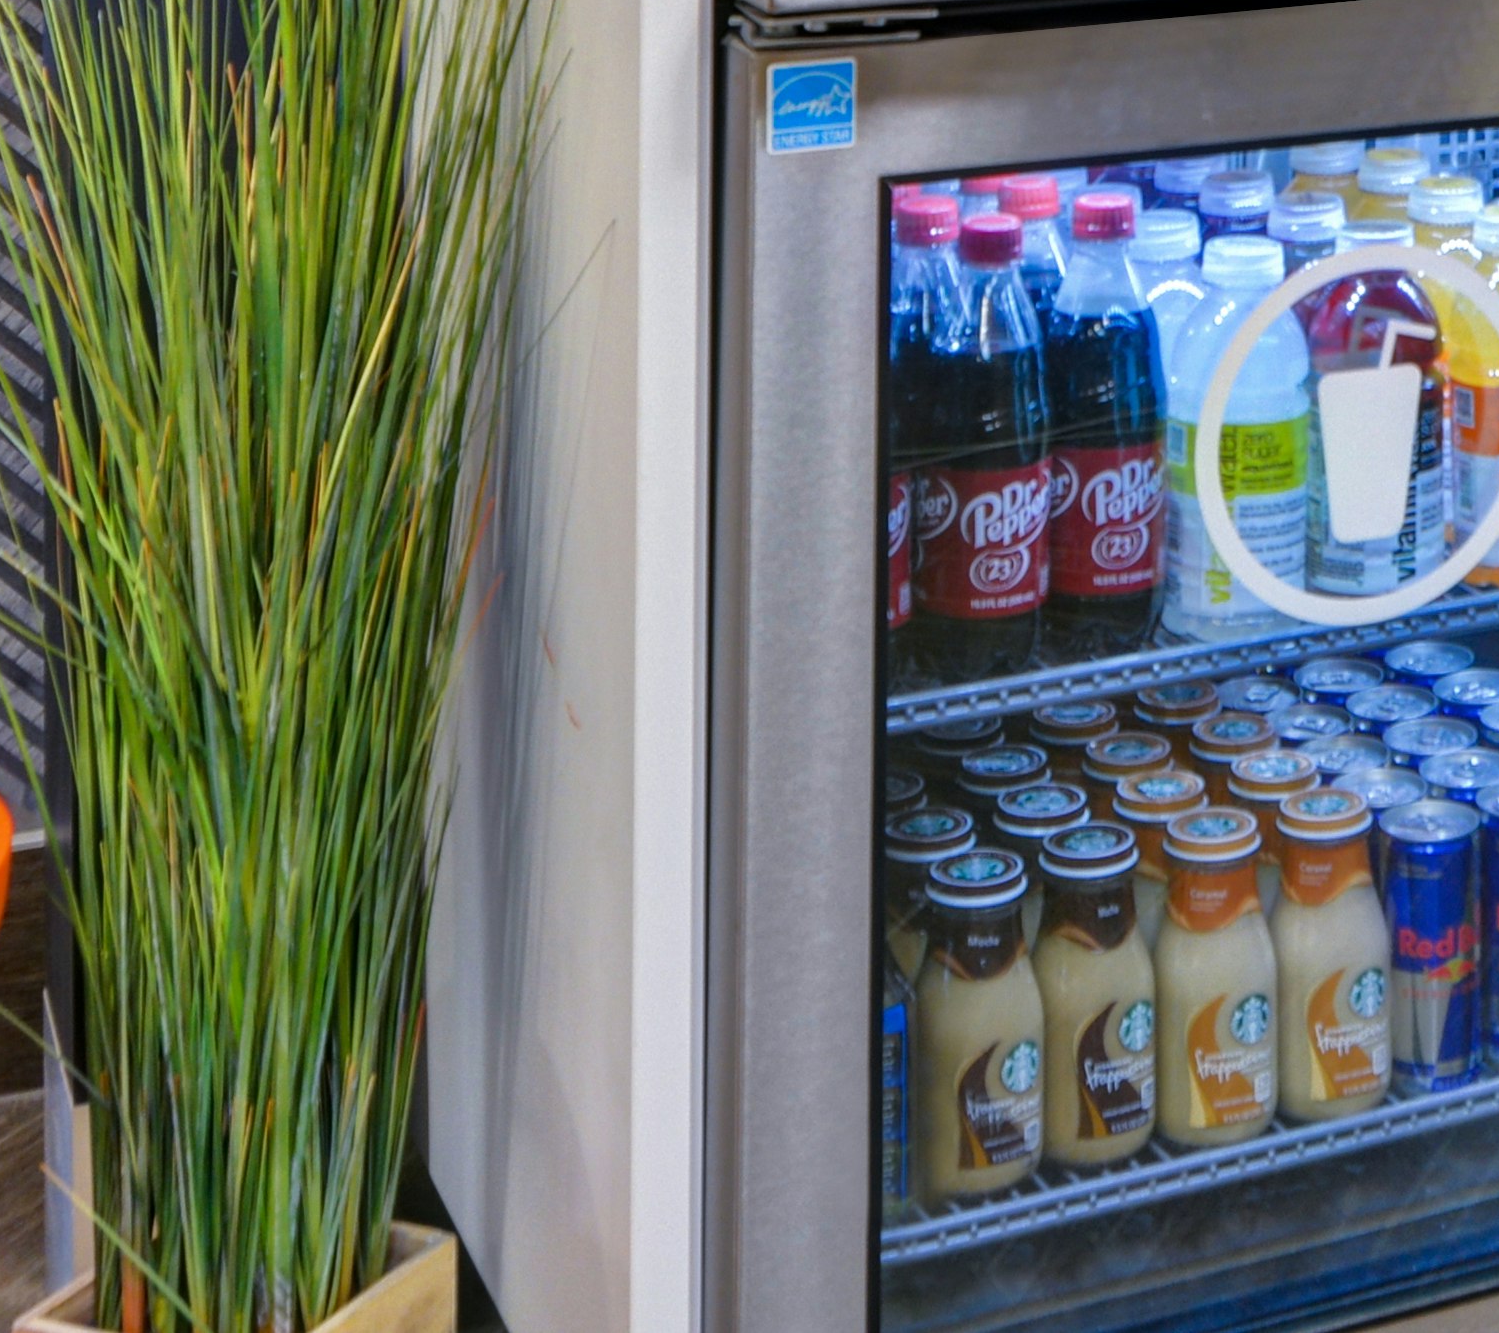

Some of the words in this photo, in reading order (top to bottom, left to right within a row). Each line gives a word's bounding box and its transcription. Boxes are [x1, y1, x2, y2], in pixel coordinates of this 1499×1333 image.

[1121, 457, 1156, 492] Dr
[1003, 479, 1038, 517] Dr
[1108, 534, 1133, 559] 23
[987, 557, 1013, 582] 23
[1398, 926, 1456, 959] Red
